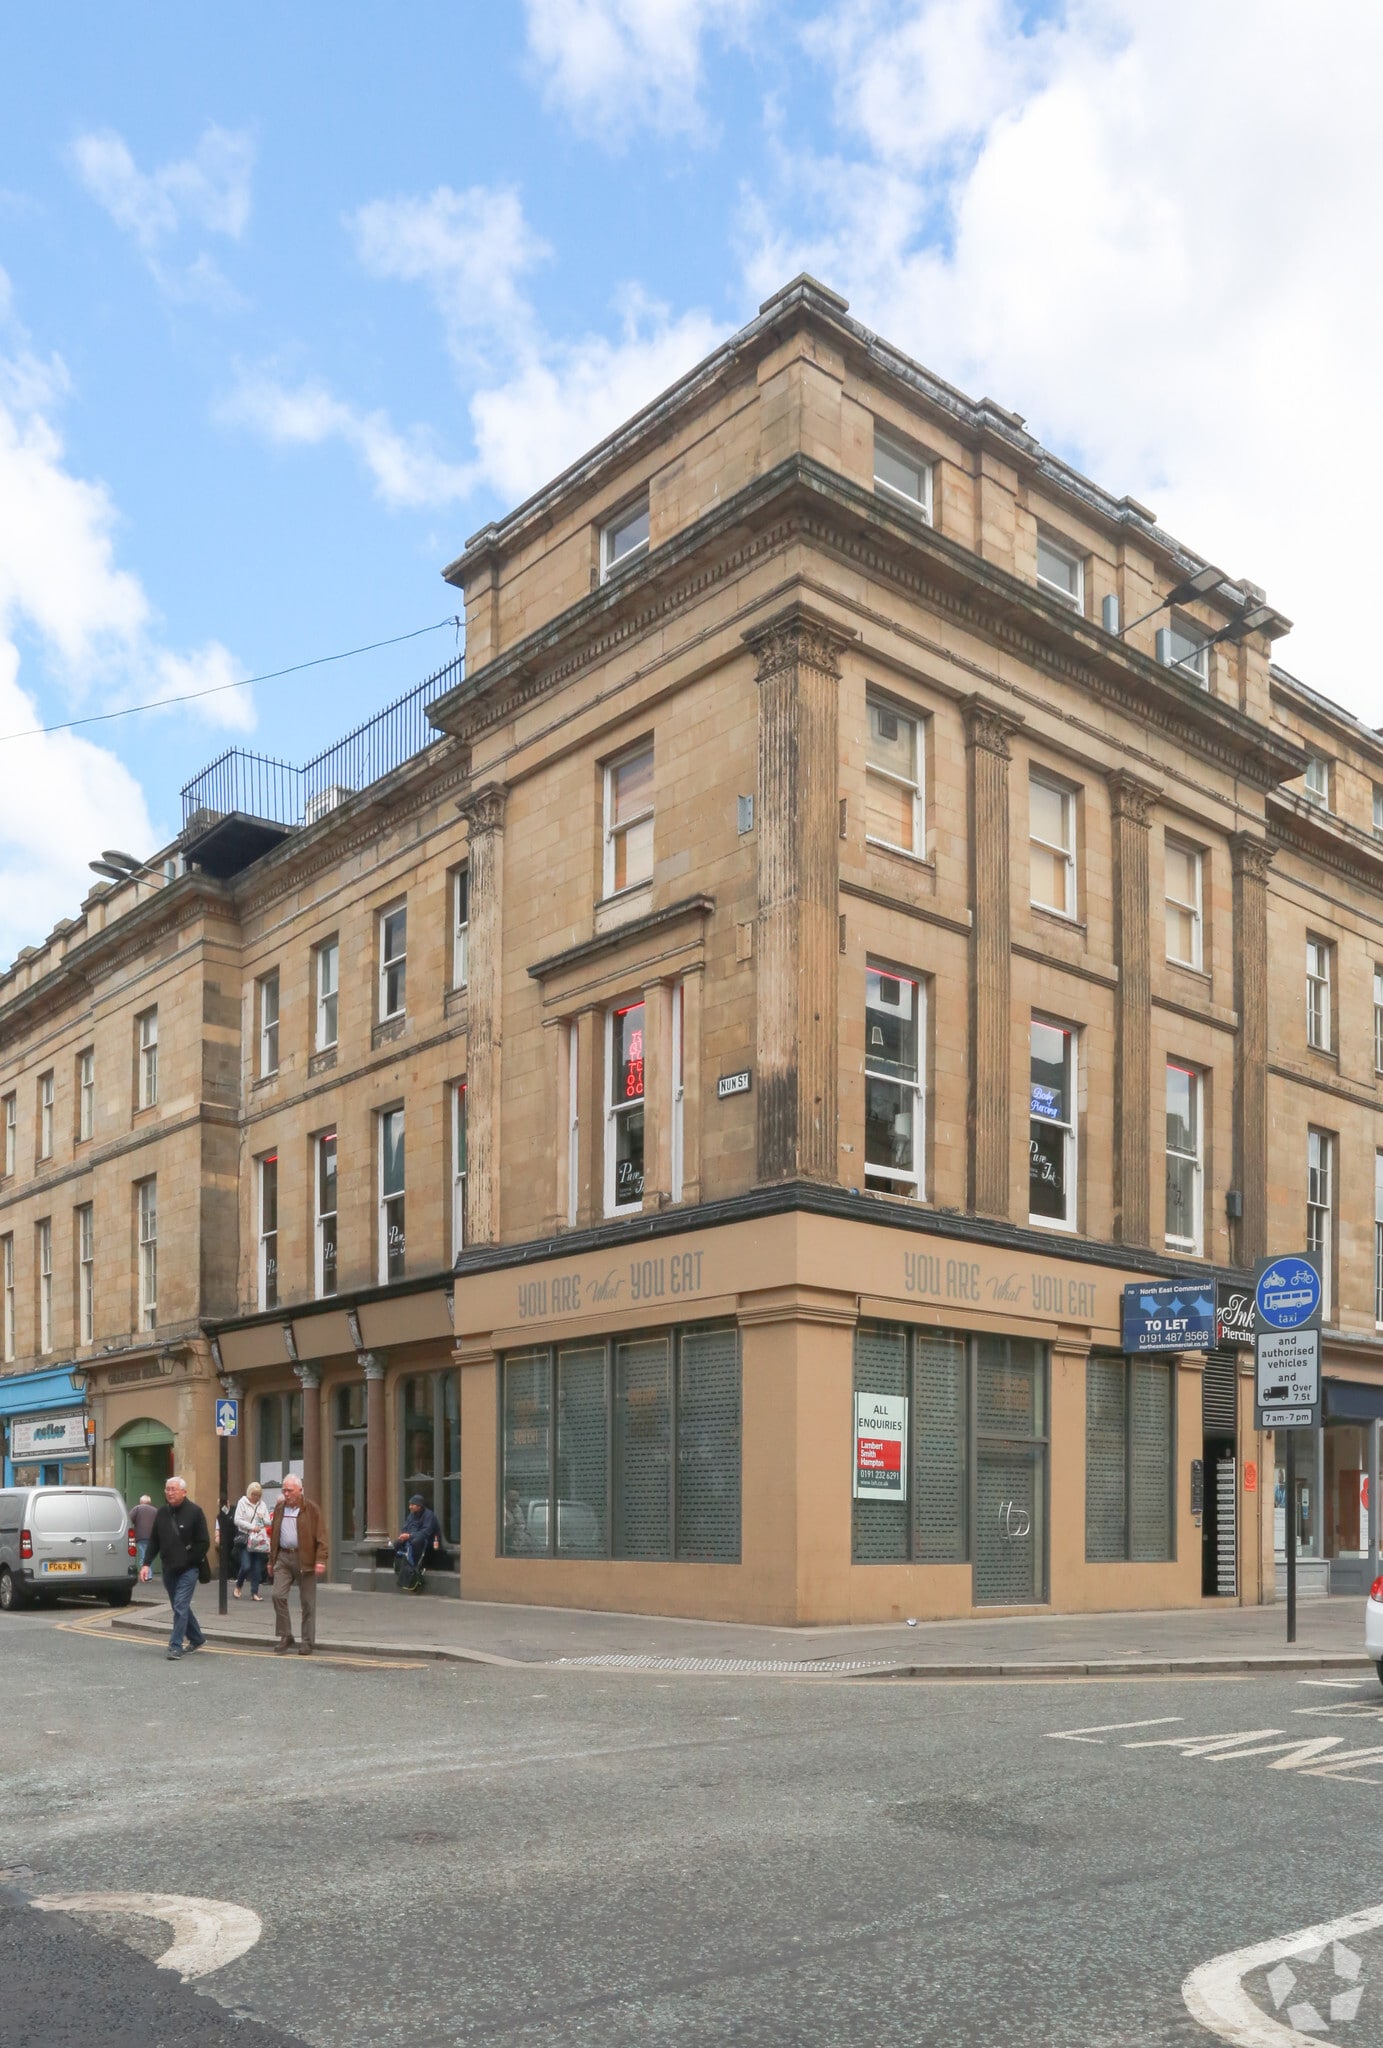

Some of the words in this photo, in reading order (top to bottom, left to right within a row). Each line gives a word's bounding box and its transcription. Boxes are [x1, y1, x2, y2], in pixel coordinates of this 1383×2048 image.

[721, 1078, 737, 1092] NUN
[518, 1279, 547, 1319] YOU
[551, 1274, 581, 1314] ARE
[586, 1269, 625, 1303] What
[630, 1258, 665, 1300] YOU
[670, 1251, 704, 1294] EAT
[904, 1251, 941, 1296] YOU
[946, 1259, 981, 1302] ARE
[986, 1273, 1027, 1303] What
[1032, 1274, 1064, 1313] YOU
[1068, 1280, 1097, 1318] EAT
[1158, 1286, 1172, 1294] East
[1173, 1284, 1211, 1292] Commercial
[1221, 1294, 1256, 1329] Ink
[1278, 1312, 1297, 1324] taxi
[1145, 1320, 1162, 1331] TO
[1165, 1319, 1188, 1330] LET
[1139, 1333, 1161, 1344] 0191
[1165, 1332, 1182, 1342] 487
[1222, 1326, 1256, 1346] Piercing
[1278, 1335, 1297, 1346] and
[1261, 1346, 1314, 1358] authorised
[1267, 1359, 1307, 1369] vehicles
[1278, 1373, 1297, 1382] and
[1292, 1384, 1312, 1392] Over
[1294, 1393, 1311, 1401] 7.5t
[873, 1405, 888, 1415] ALL
[858, 1417, 902, 1431] ENQUIRIES
[36, 1423, 66, 1437] reflex
[860, 1441, 883, 1450] Lambert
[860, 1449, 876, 1458] Smith
[860, 1457, 884, 1468] Hampton
[860, 1470, 874, 1478] 0191
[875, 1471, 886, 1479] 232
[886, 1472, 899, 1480] 6291
